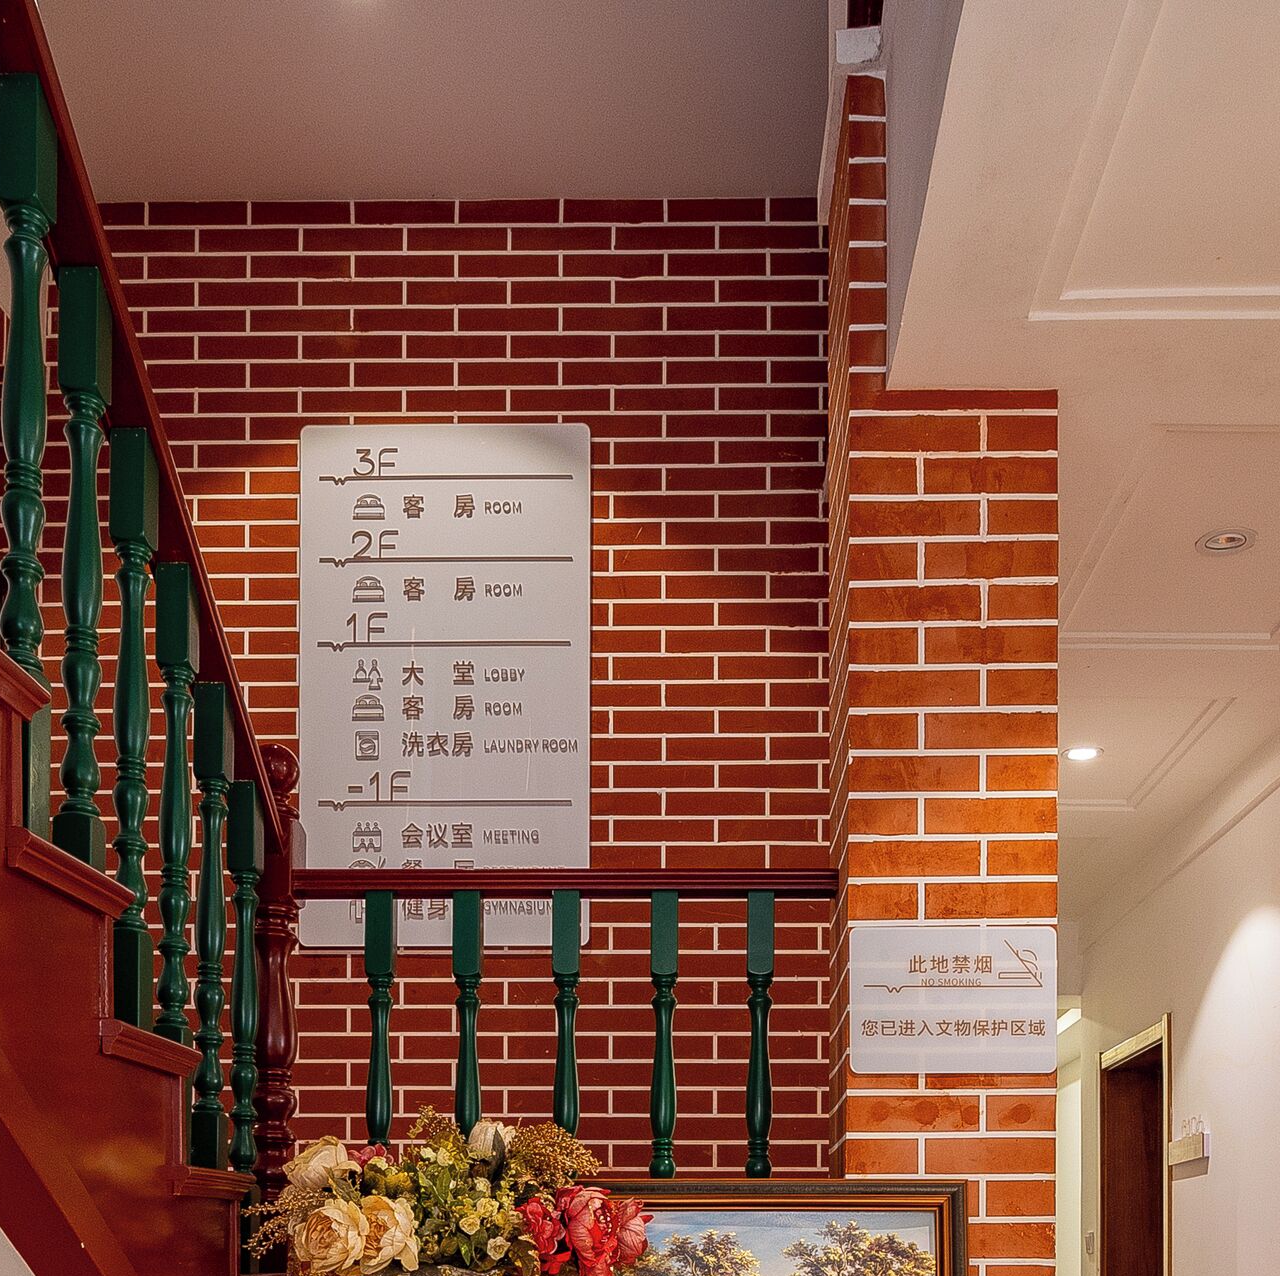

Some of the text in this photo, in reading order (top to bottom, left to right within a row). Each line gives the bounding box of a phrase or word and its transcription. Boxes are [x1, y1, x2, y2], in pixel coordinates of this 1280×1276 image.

[353, 448, 398, 477] 3F
[403, 495, 522, 519] 客房 ROOM
[352, 530, 399, 558] 2F
[403, 577, 523, 601] 客房 ROOM
[347, 613, 388, 642] 1F
[402, 661, 525, 685] 大堂 LOBBY
[402, 695, 522, 720] 客房 ROOM
[402, 732, 578, 757] 洗衣房 LAUNDRY ROOM
[348, 771, 411, 800] -1F
[401, 822, 540, 848] 会议室 MEETING
[908, 955, 993, 974] 此地禁烟
[921, 978, 982, 987] NO SMOKING
[861, 1019, 1046, 1037] 您已进入文物保护区域
